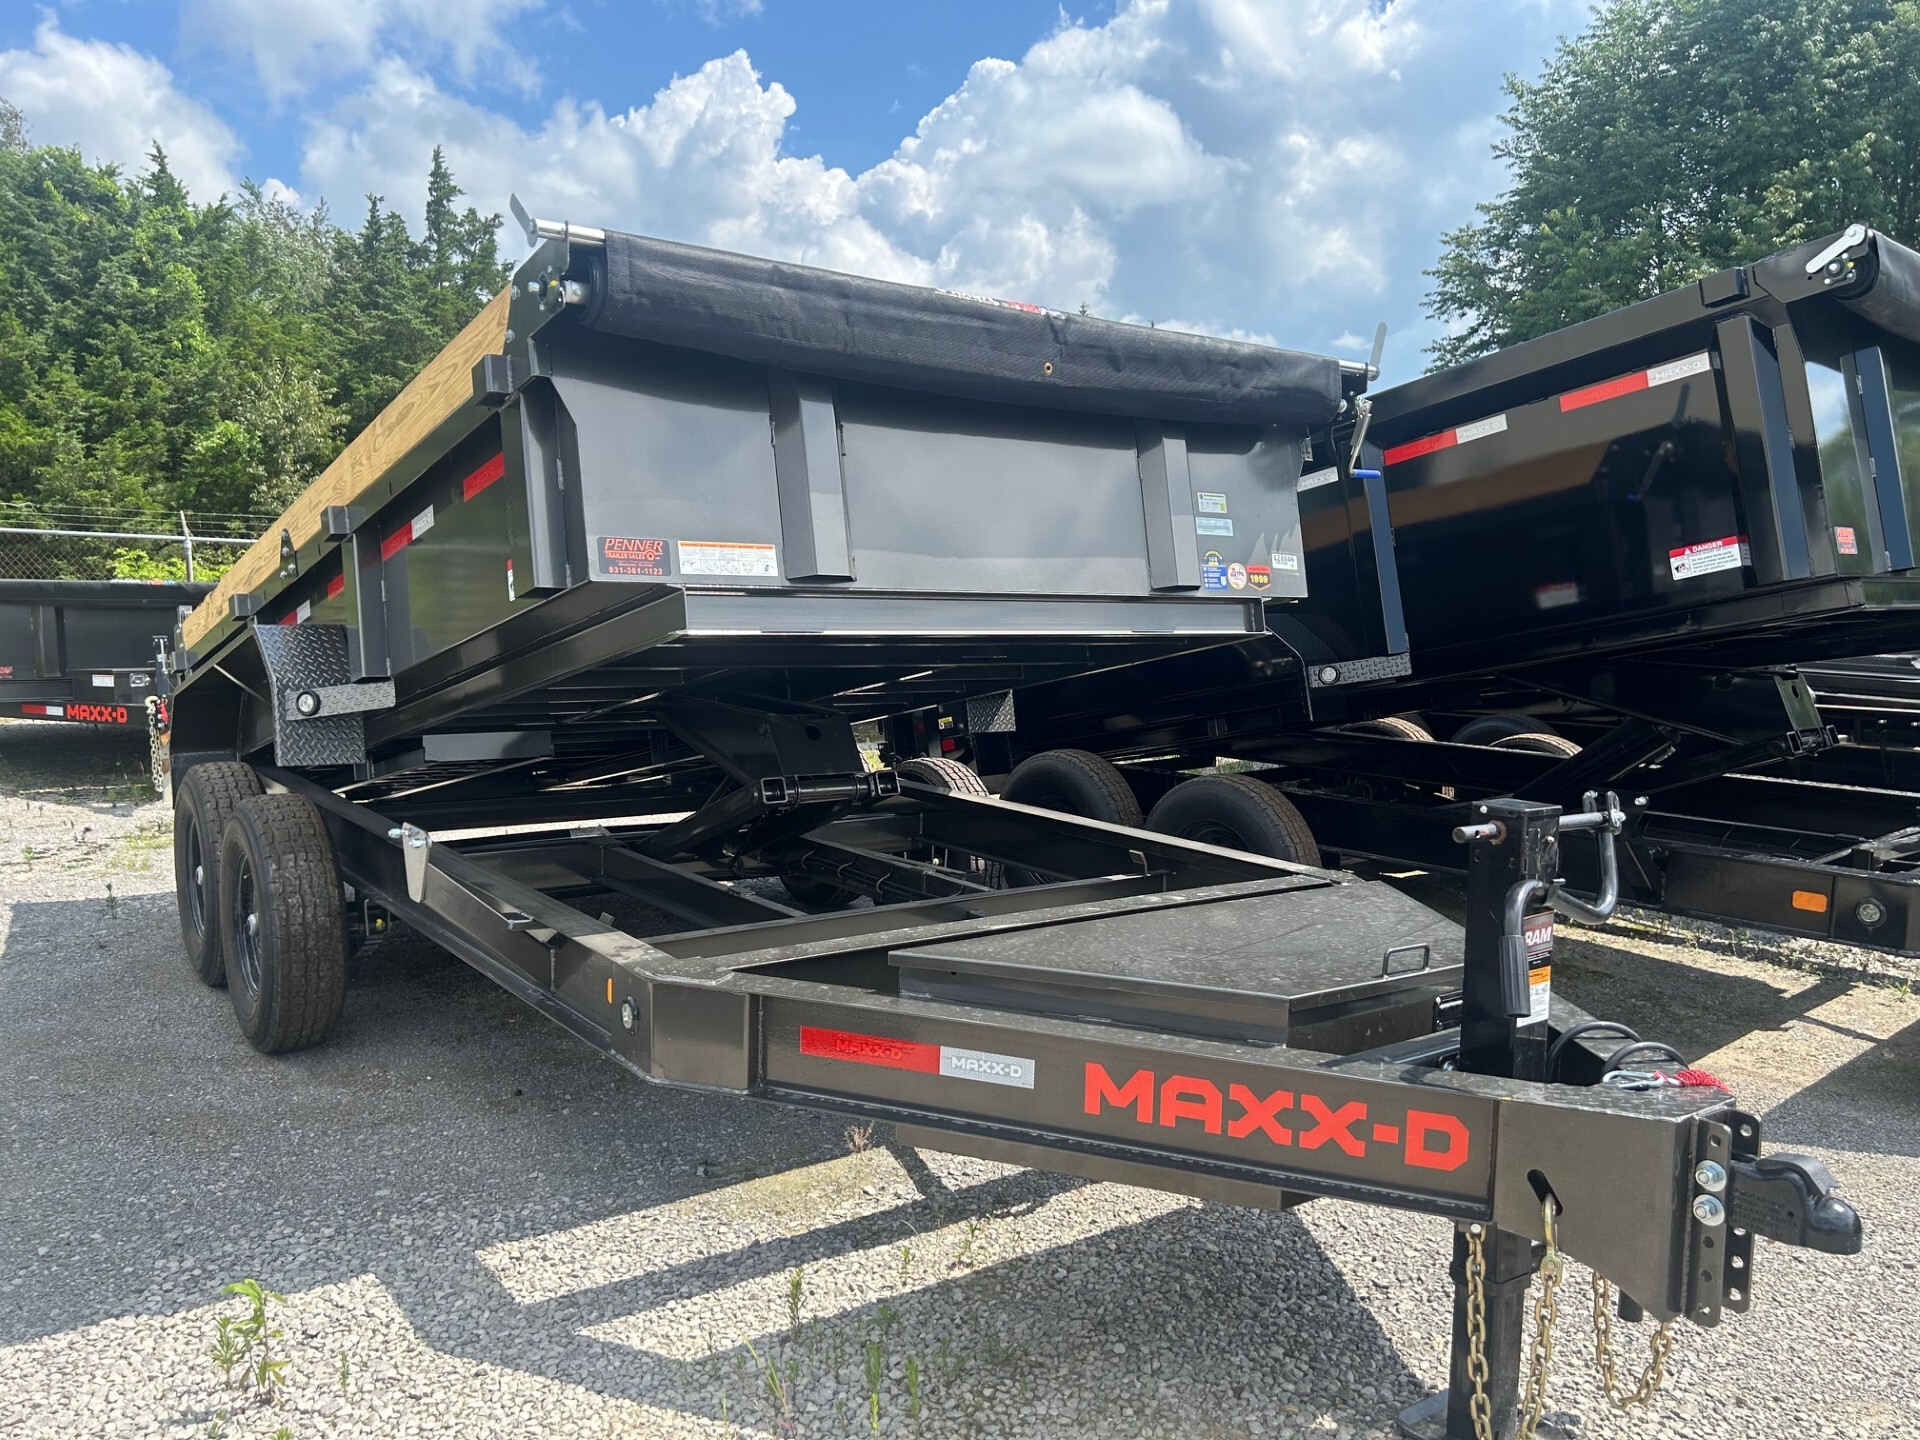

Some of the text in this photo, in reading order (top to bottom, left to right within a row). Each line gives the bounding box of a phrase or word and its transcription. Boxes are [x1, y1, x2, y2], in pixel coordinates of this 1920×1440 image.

[1655, 360, 1701, 381] MAXX-D
[1462, 421, 1500, 438] MAXX-D
[604, 538, 663, 553] PENNER
[1692, 541, 1723, 552] DANGER
[628, 552, 645, 560] SALES
[66, 704, 128, 723] MAXX-D
[835, 1038, 903, 1061] MAXX-D
[951, 1056, 1022, 1078] MAXX-D
[1084, 1062, 1470, 1171] MAXX-D
